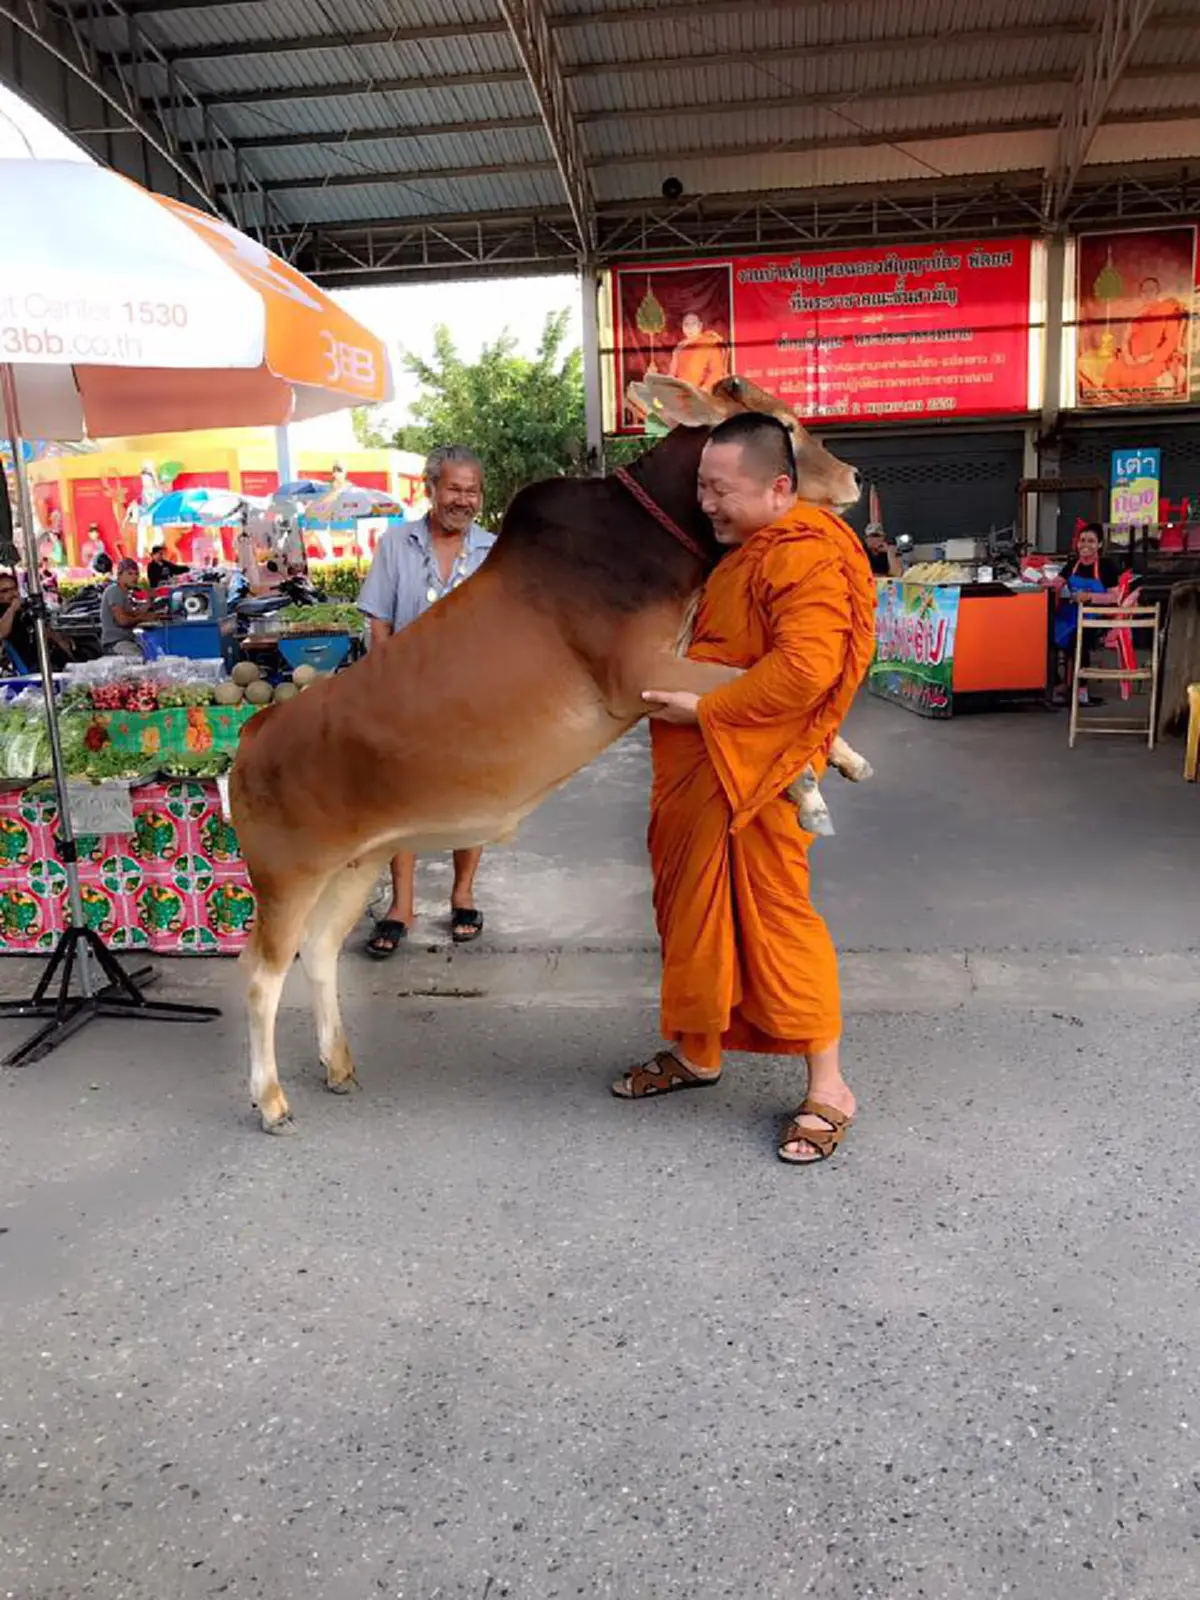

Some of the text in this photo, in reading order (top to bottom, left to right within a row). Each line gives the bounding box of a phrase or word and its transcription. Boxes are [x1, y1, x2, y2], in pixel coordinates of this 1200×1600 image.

[967, 247, 1013, 269] พัดยศ
[788, 275, 958, 313] ที่พระราชาคณะชั้นสามัญ
[121, 300, 188, 328] 1530
[2, 326, 143, 360] 3bb.co.th
